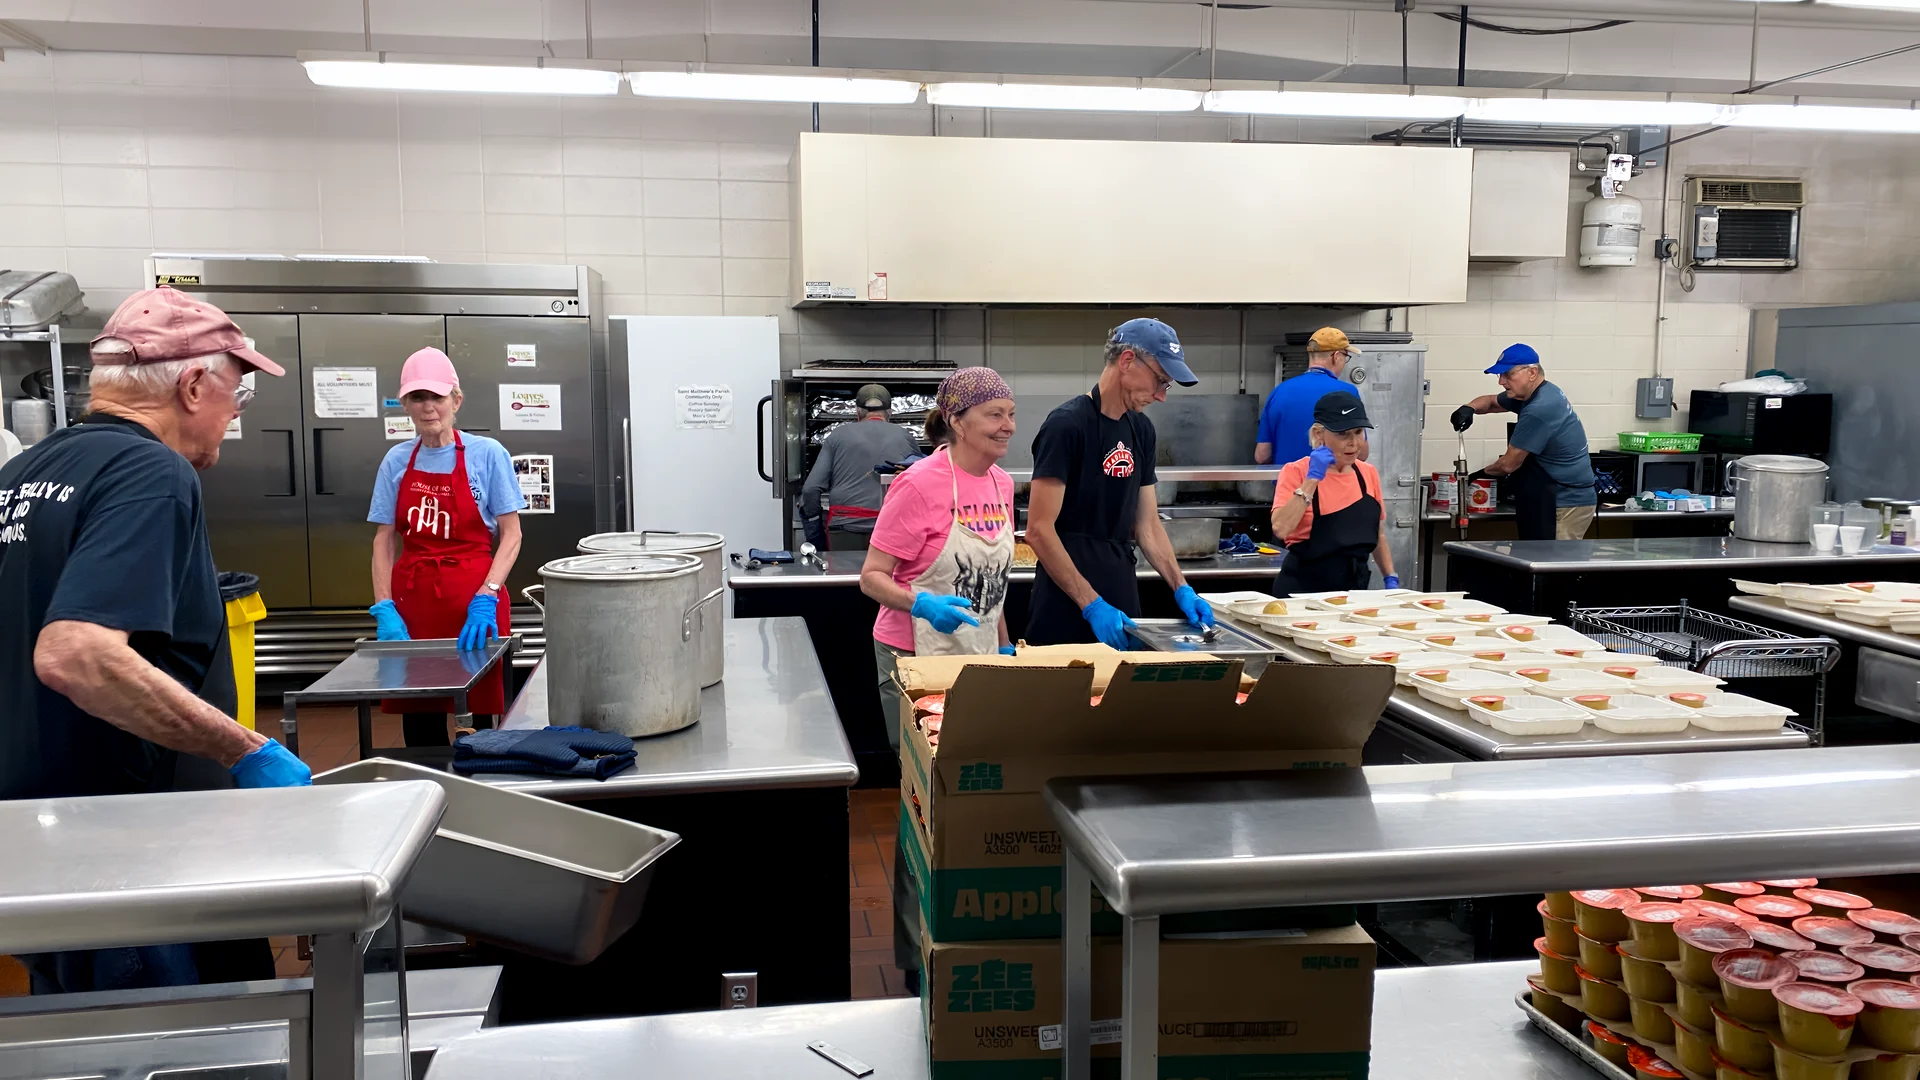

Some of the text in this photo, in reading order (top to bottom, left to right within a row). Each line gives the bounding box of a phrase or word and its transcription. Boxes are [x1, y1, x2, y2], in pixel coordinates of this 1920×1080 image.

[512, 391, 544, 400] Loaves
[958, 777, 1003, 791] ZEES
[984, 830, 1063, 845] UNSWEET
[984, 844, 1020, 855] A3500
[948, 989, 1036, 1013] ZEES
[977, 1037, 1013, 1048] A3500
